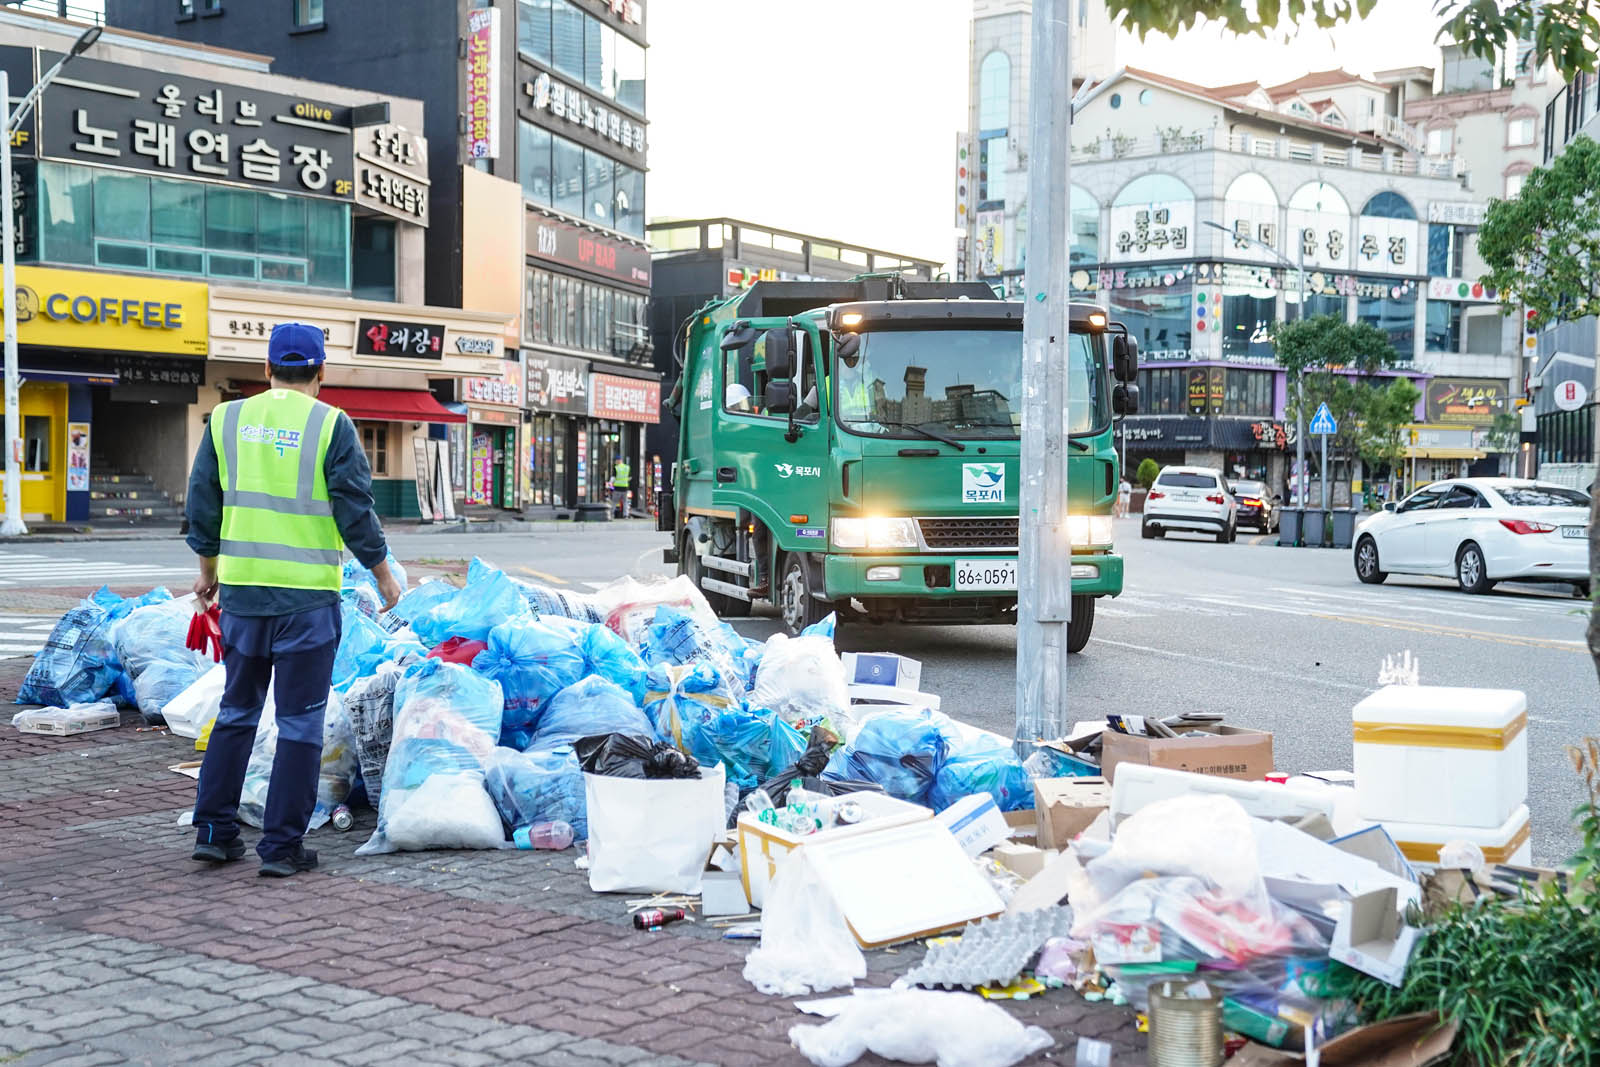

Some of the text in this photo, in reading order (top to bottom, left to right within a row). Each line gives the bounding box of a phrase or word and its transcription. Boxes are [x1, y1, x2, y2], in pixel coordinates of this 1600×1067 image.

[156, 83, 264, 127] 올리브
[294, 103, 333, 121] olive
[75, 108, 333, 190] 노래연습장
[335, 179, 353, 195] 2F
[364, 168, 424, 217] 노래연습장
[1116, 227, 1187, 253] 유흥주점
[46, 292, 183, 329] COFFEE
[275, 429, 300, 457] 목포
[795, 466, 821, 478] 목포시
[966, 490, 1002, 501] 목포시
[958, 569, 1015, 585] 86수0591
